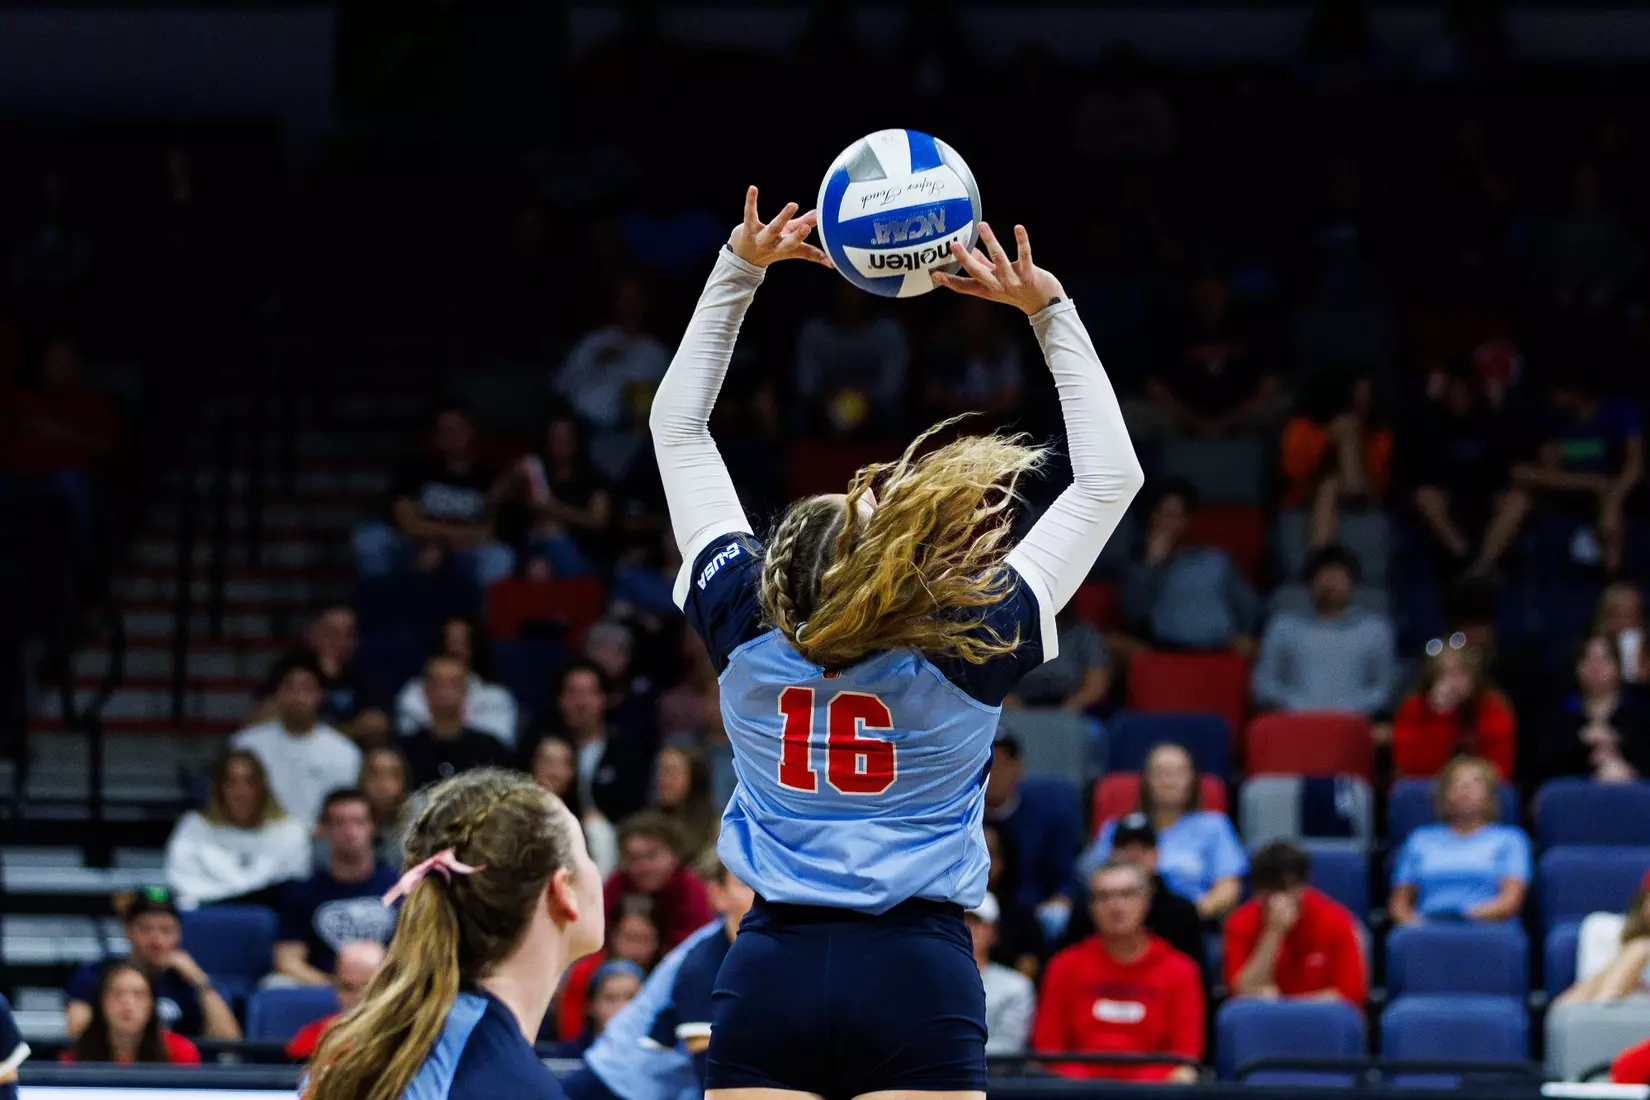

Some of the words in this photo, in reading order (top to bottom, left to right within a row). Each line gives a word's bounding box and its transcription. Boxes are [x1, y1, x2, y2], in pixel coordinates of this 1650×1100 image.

[860, 186, 902, 209] Touch
[906, 177, 945, 197] Super
[777, 686, 897, 795] 16
